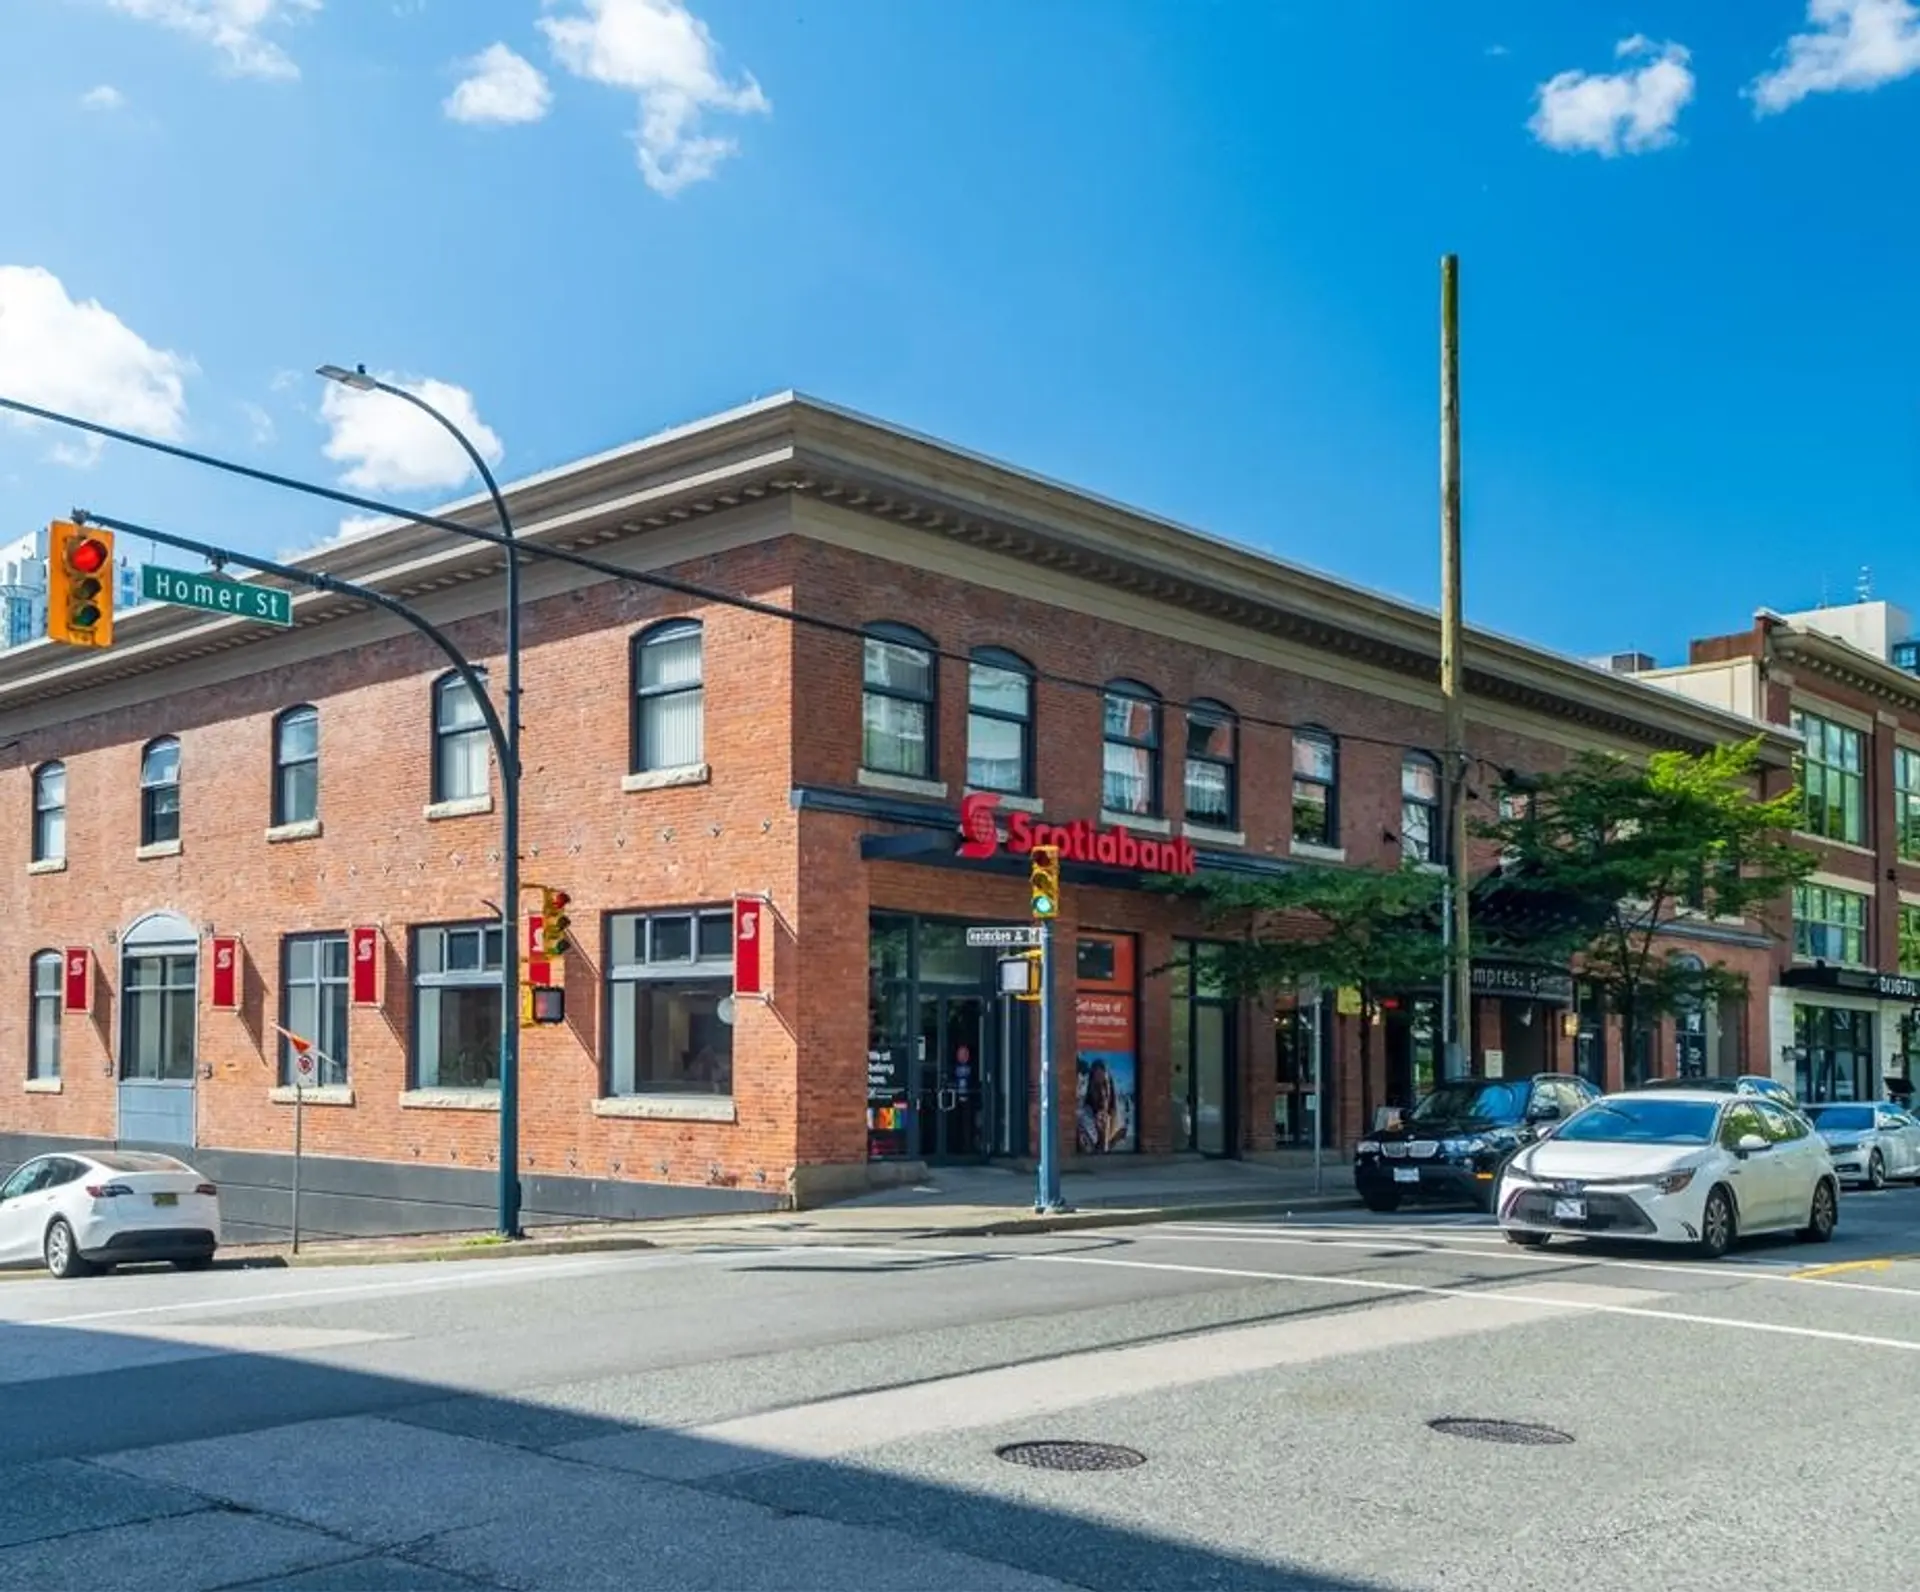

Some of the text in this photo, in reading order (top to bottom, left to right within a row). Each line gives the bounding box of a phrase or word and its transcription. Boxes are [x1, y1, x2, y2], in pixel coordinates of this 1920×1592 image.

[156, 573, 278, 617] Homer St
[1007, 811, 1196, 875] Scotiabank
